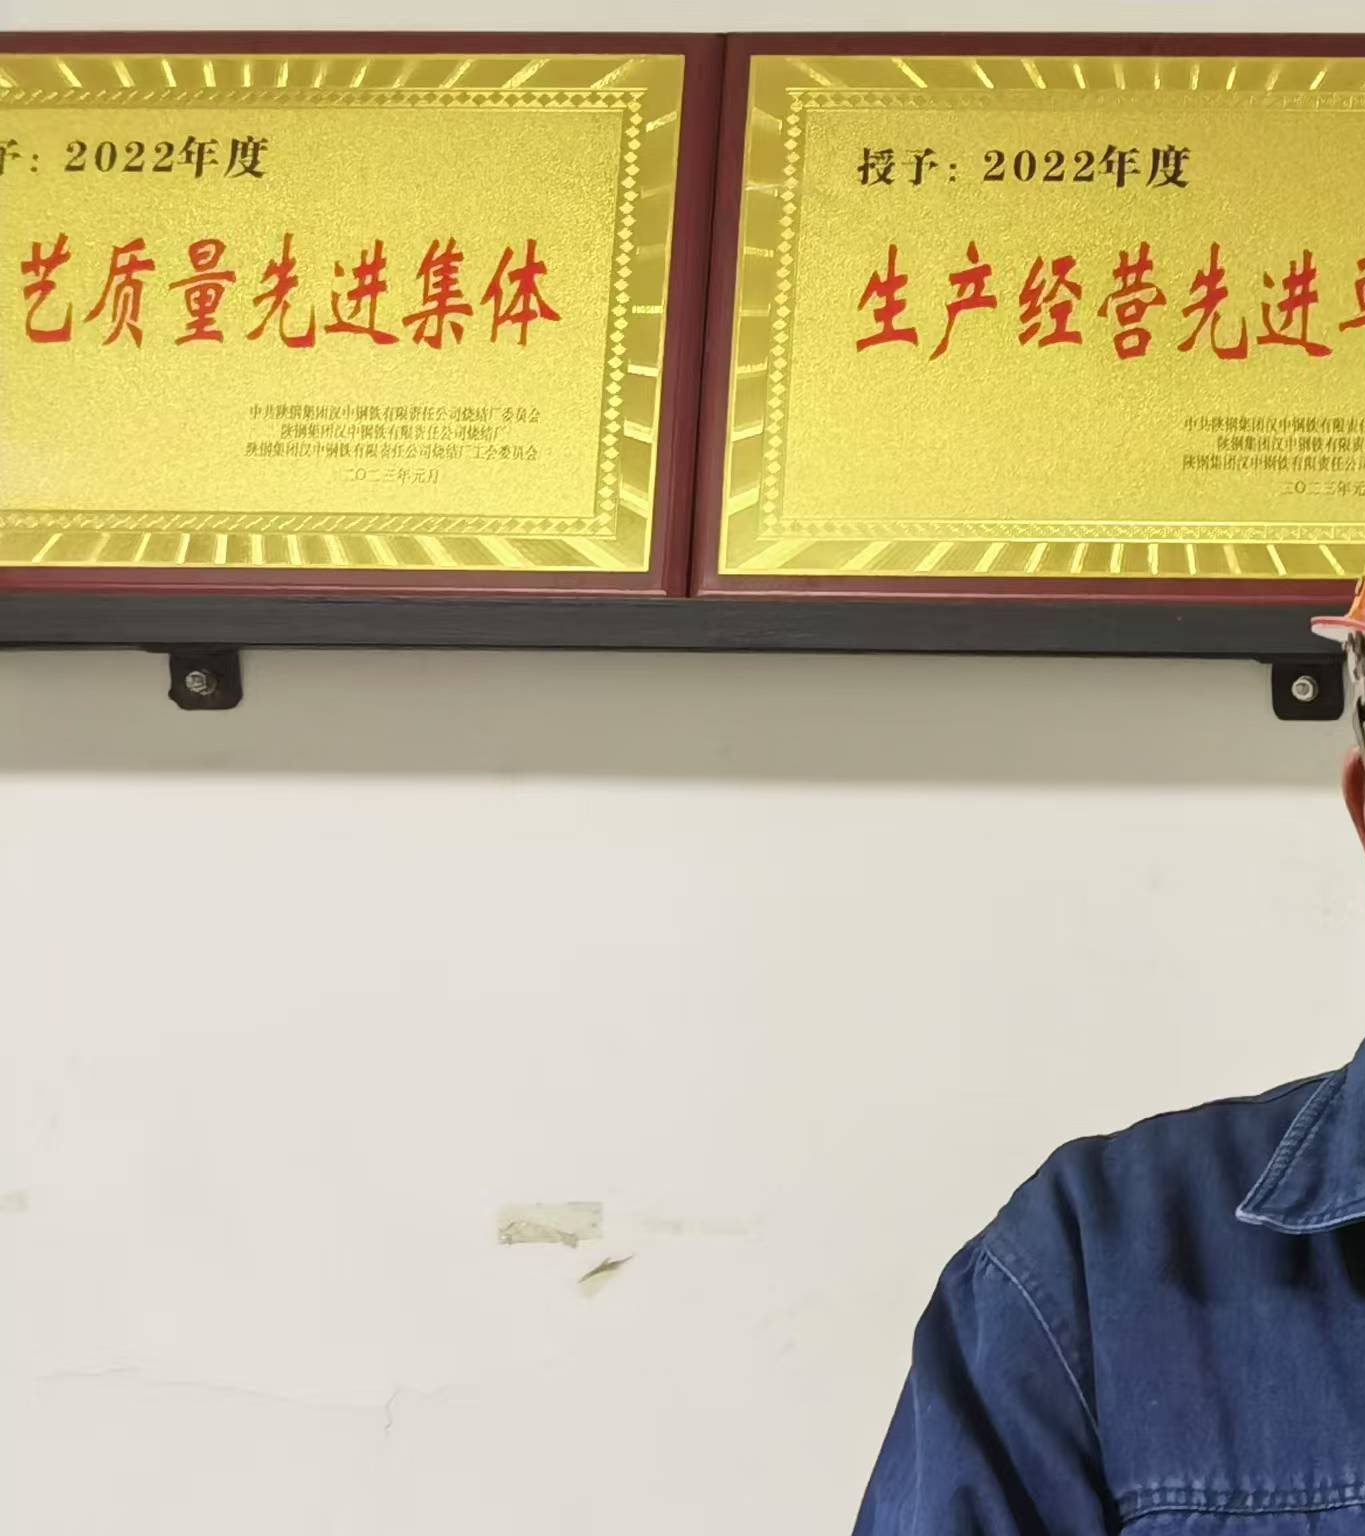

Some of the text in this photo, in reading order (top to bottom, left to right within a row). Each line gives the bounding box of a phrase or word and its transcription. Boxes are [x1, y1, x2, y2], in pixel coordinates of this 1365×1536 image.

[857, 144, 1191, 189] 授予：2022年度
[21, 232, 561, 349] 艺质量先进集体
